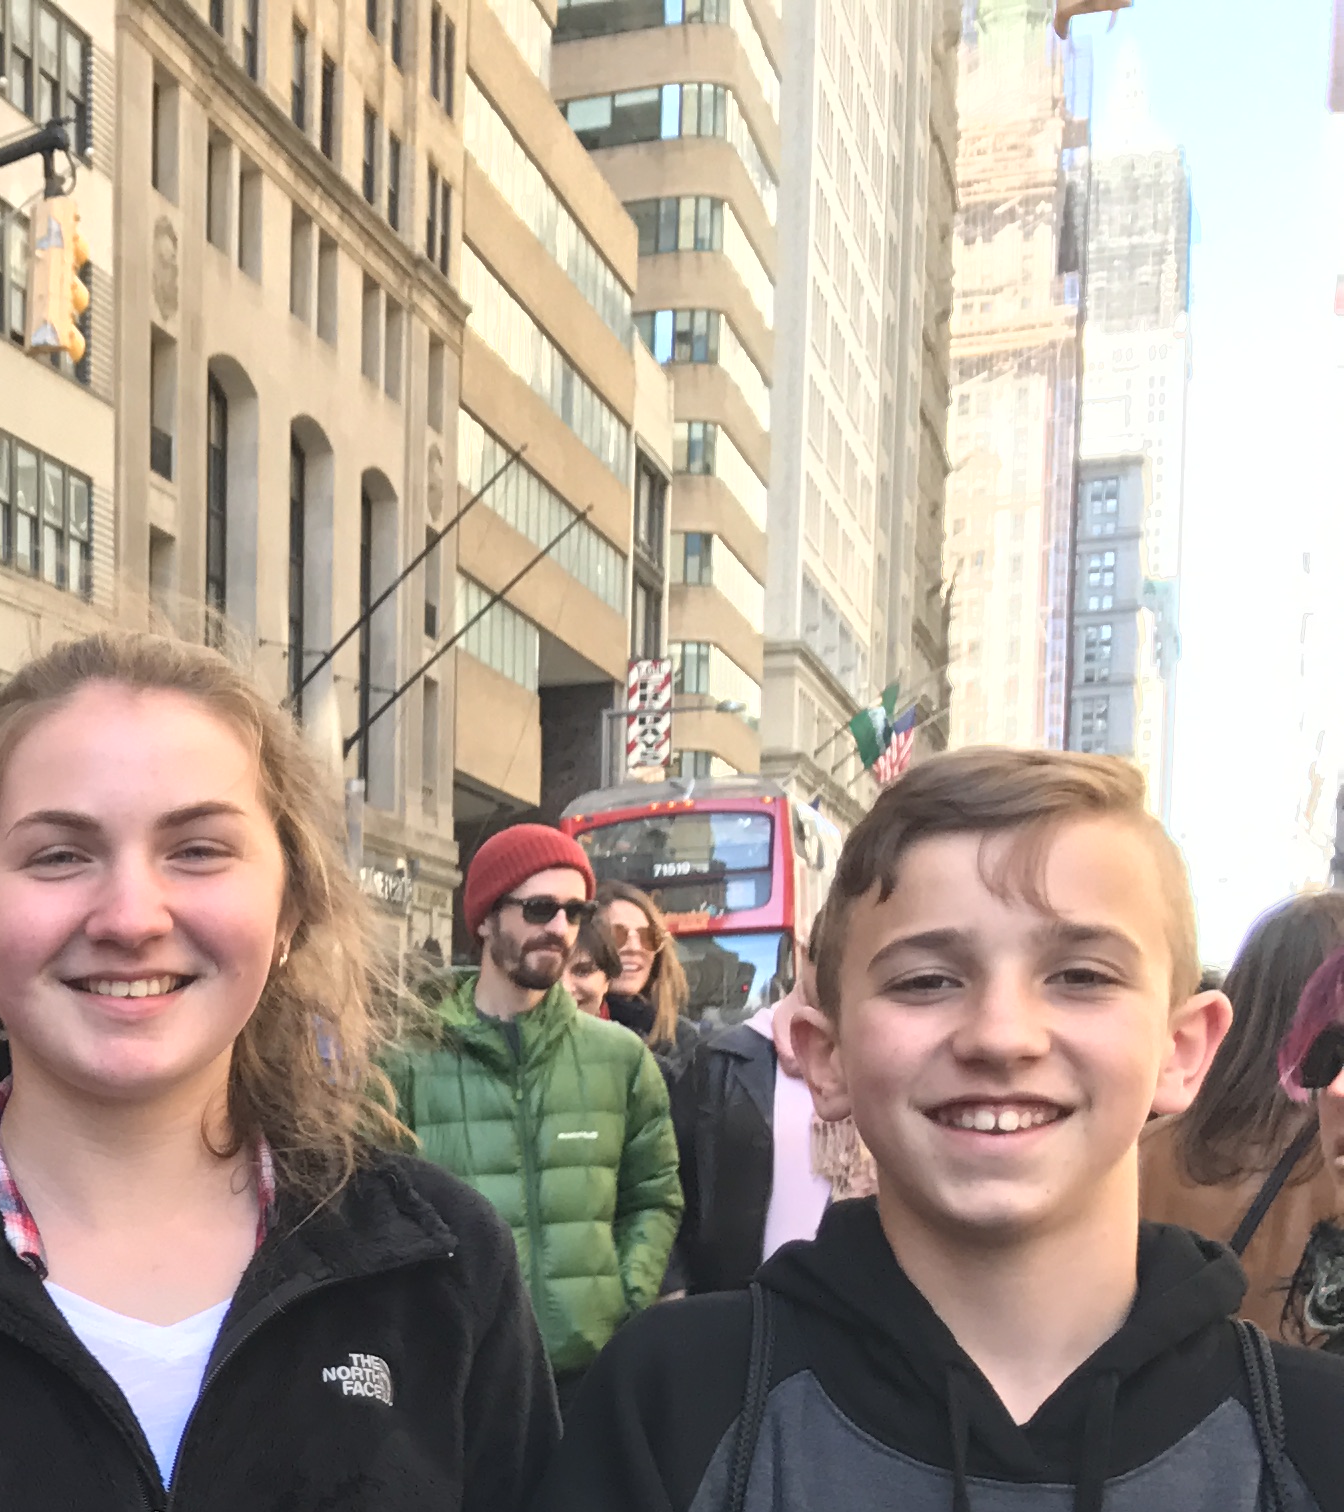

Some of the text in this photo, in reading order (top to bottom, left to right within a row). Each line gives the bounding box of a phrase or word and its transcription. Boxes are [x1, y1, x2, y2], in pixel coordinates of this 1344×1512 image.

[349, 1353, 382, 1371] THE
[322, 1366, 381, 1382] NORTH
[342, 1381, 383, 1399] FACE
